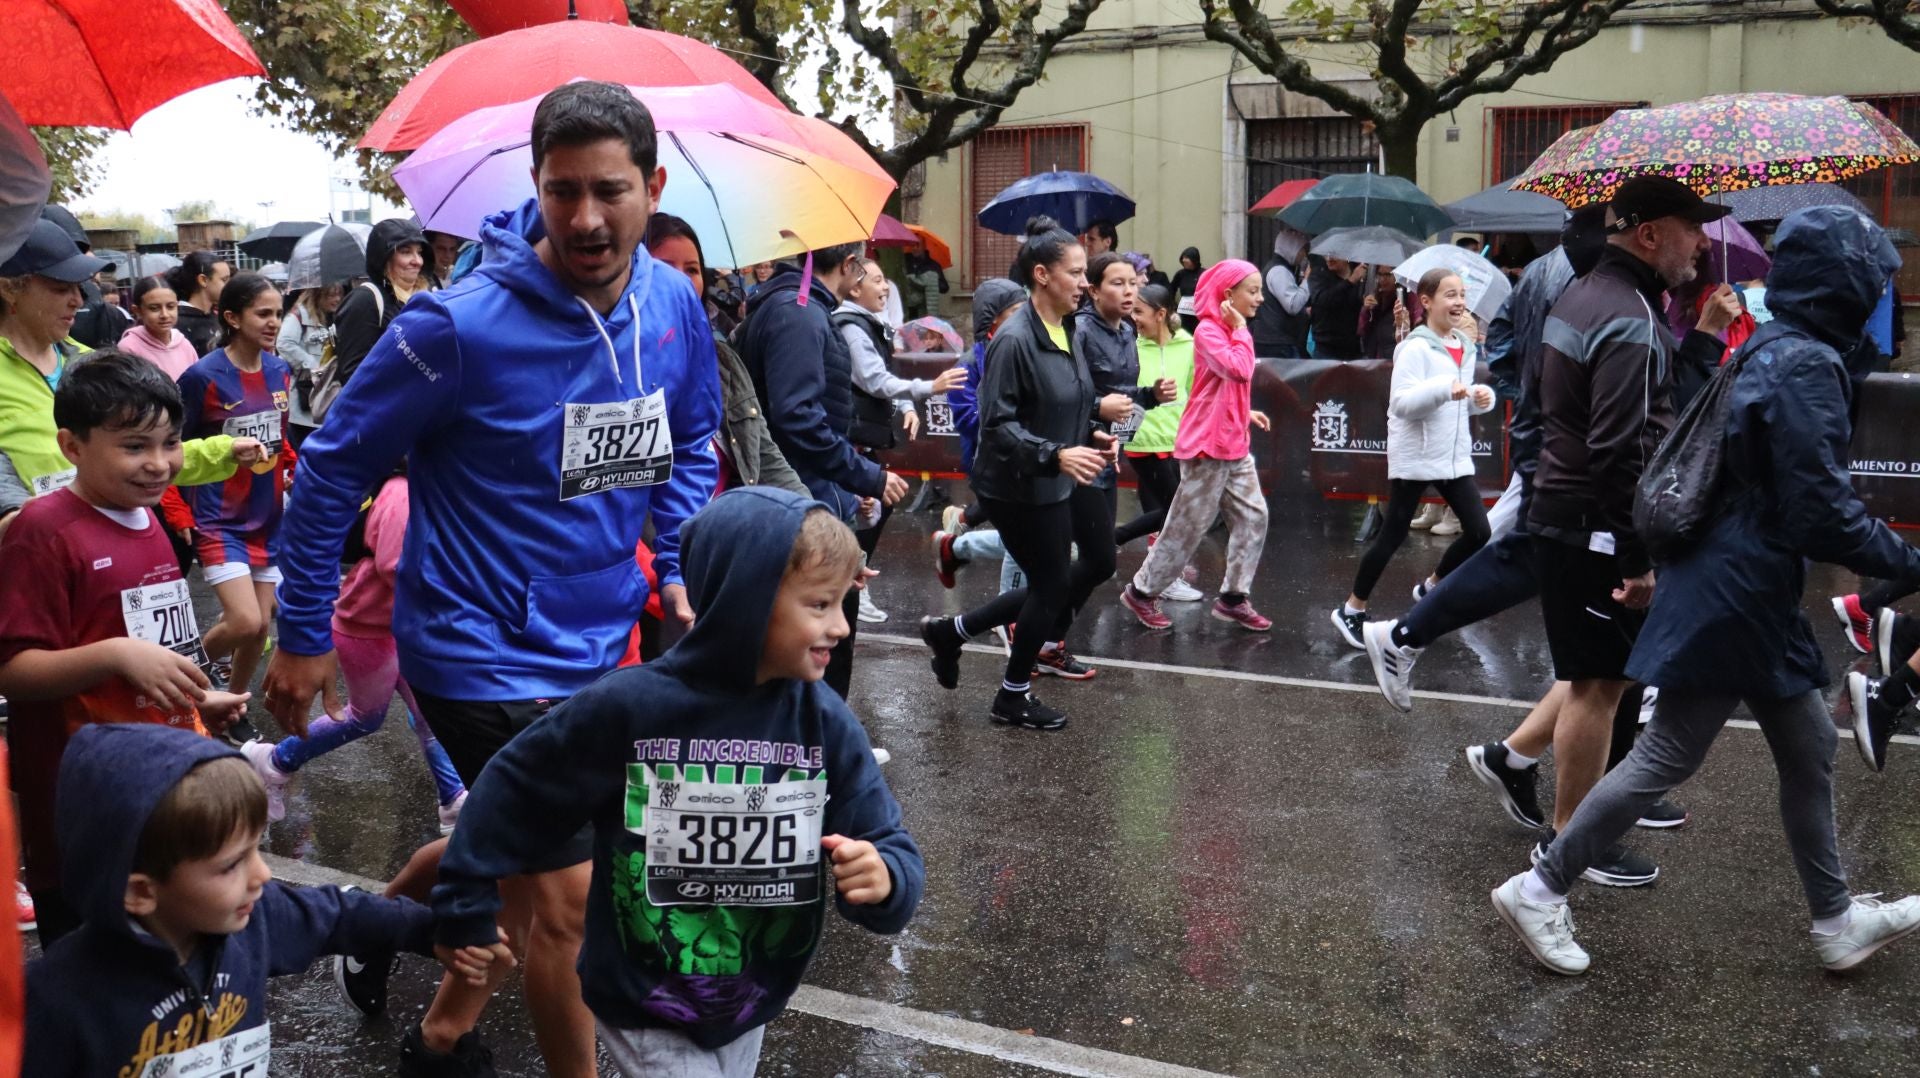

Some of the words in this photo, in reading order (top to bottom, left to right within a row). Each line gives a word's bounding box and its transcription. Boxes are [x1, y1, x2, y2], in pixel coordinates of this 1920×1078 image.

[584, 417, 660, 466] 3827
[1350, 439, 1388, 450] AYUNT
[602, 469, 656, 485] HYUNDAI
[633, 738, 681, 760] THE
[688, 739, 823, 769] INCREDIBLE
[688, 792, 735, 804] emico
[776, 789, 817, 803] emico
[678, 813, 797, 866] 3826
[714, 882, 795, 897] HYUNDAI
